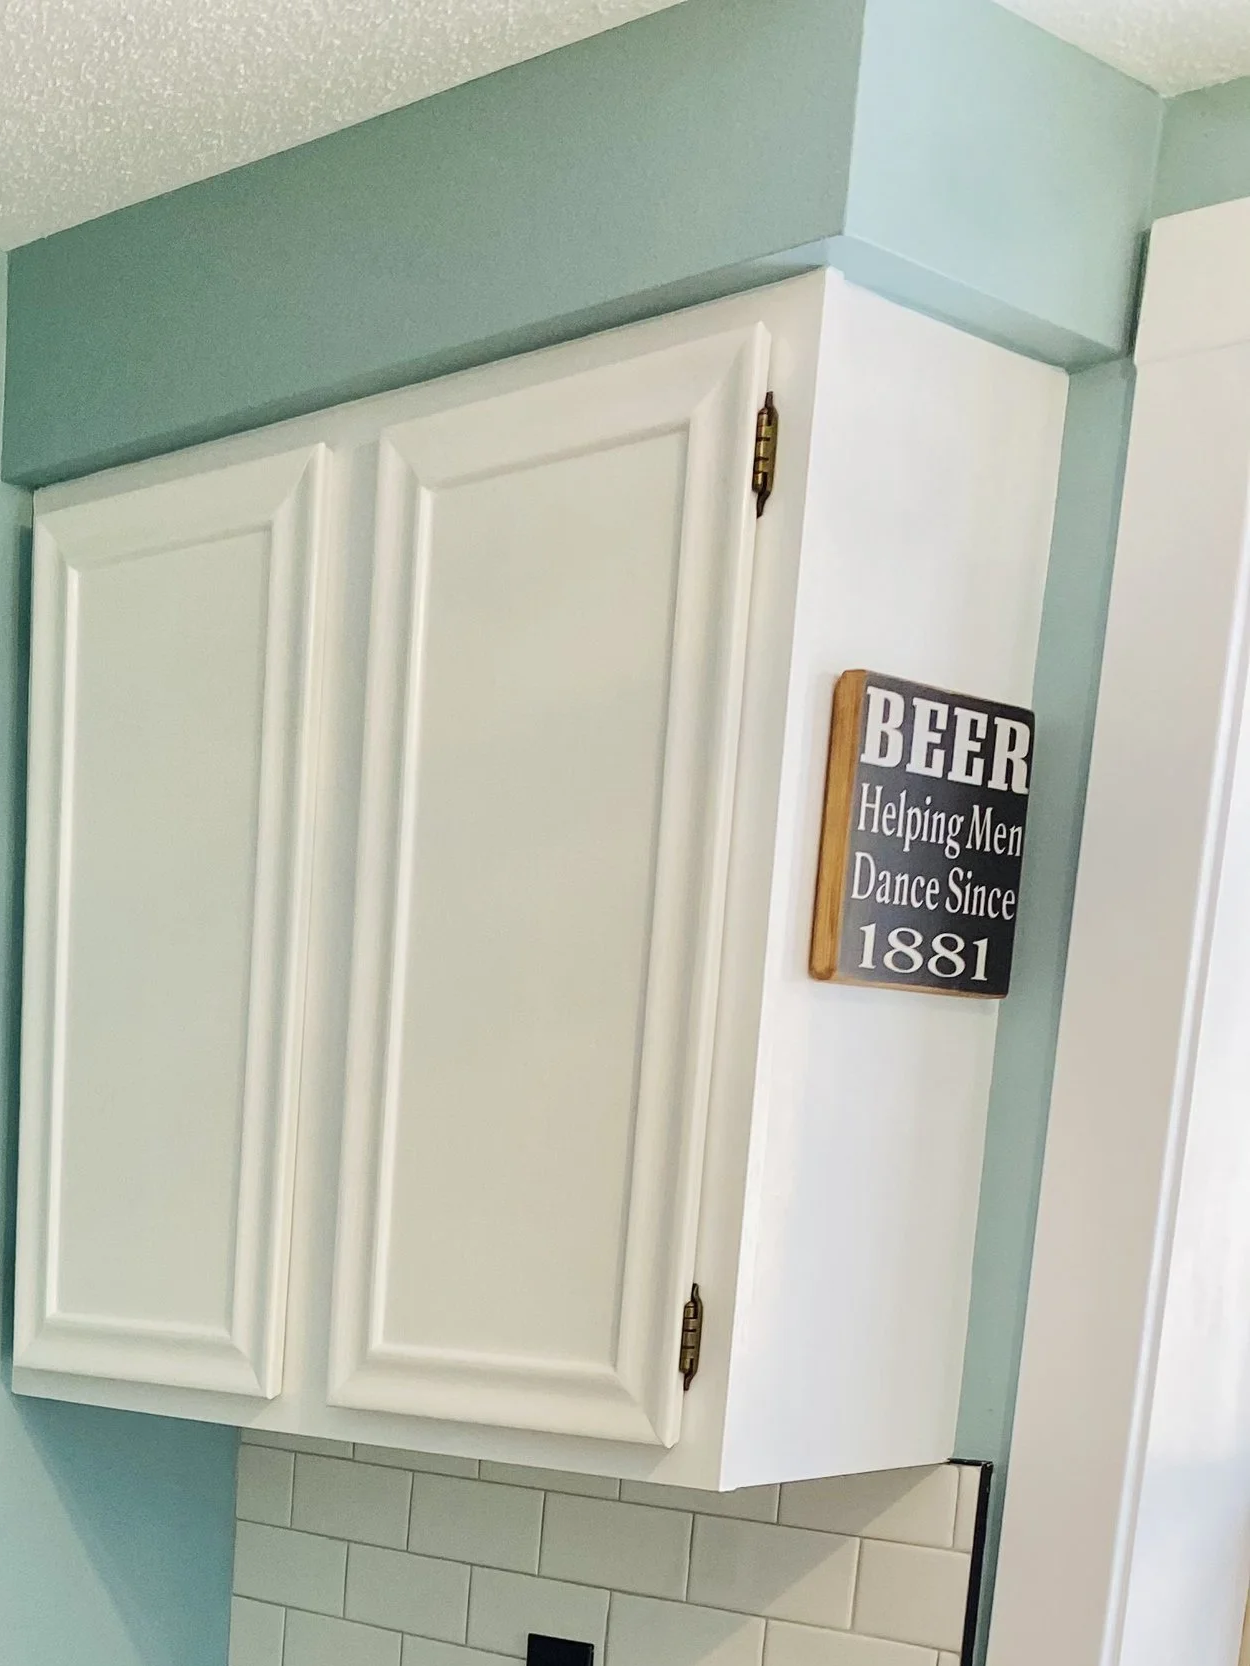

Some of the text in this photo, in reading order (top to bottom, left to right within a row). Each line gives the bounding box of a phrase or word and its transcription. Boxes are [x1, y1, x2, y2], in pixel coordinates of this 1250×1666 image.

[860, 686, 1033, 795] BEER
[857, 783, 1024, 860] Helping Men
[851, 851, 1016, 921] Dance Since
[858, 923, 989, 982] 1881
